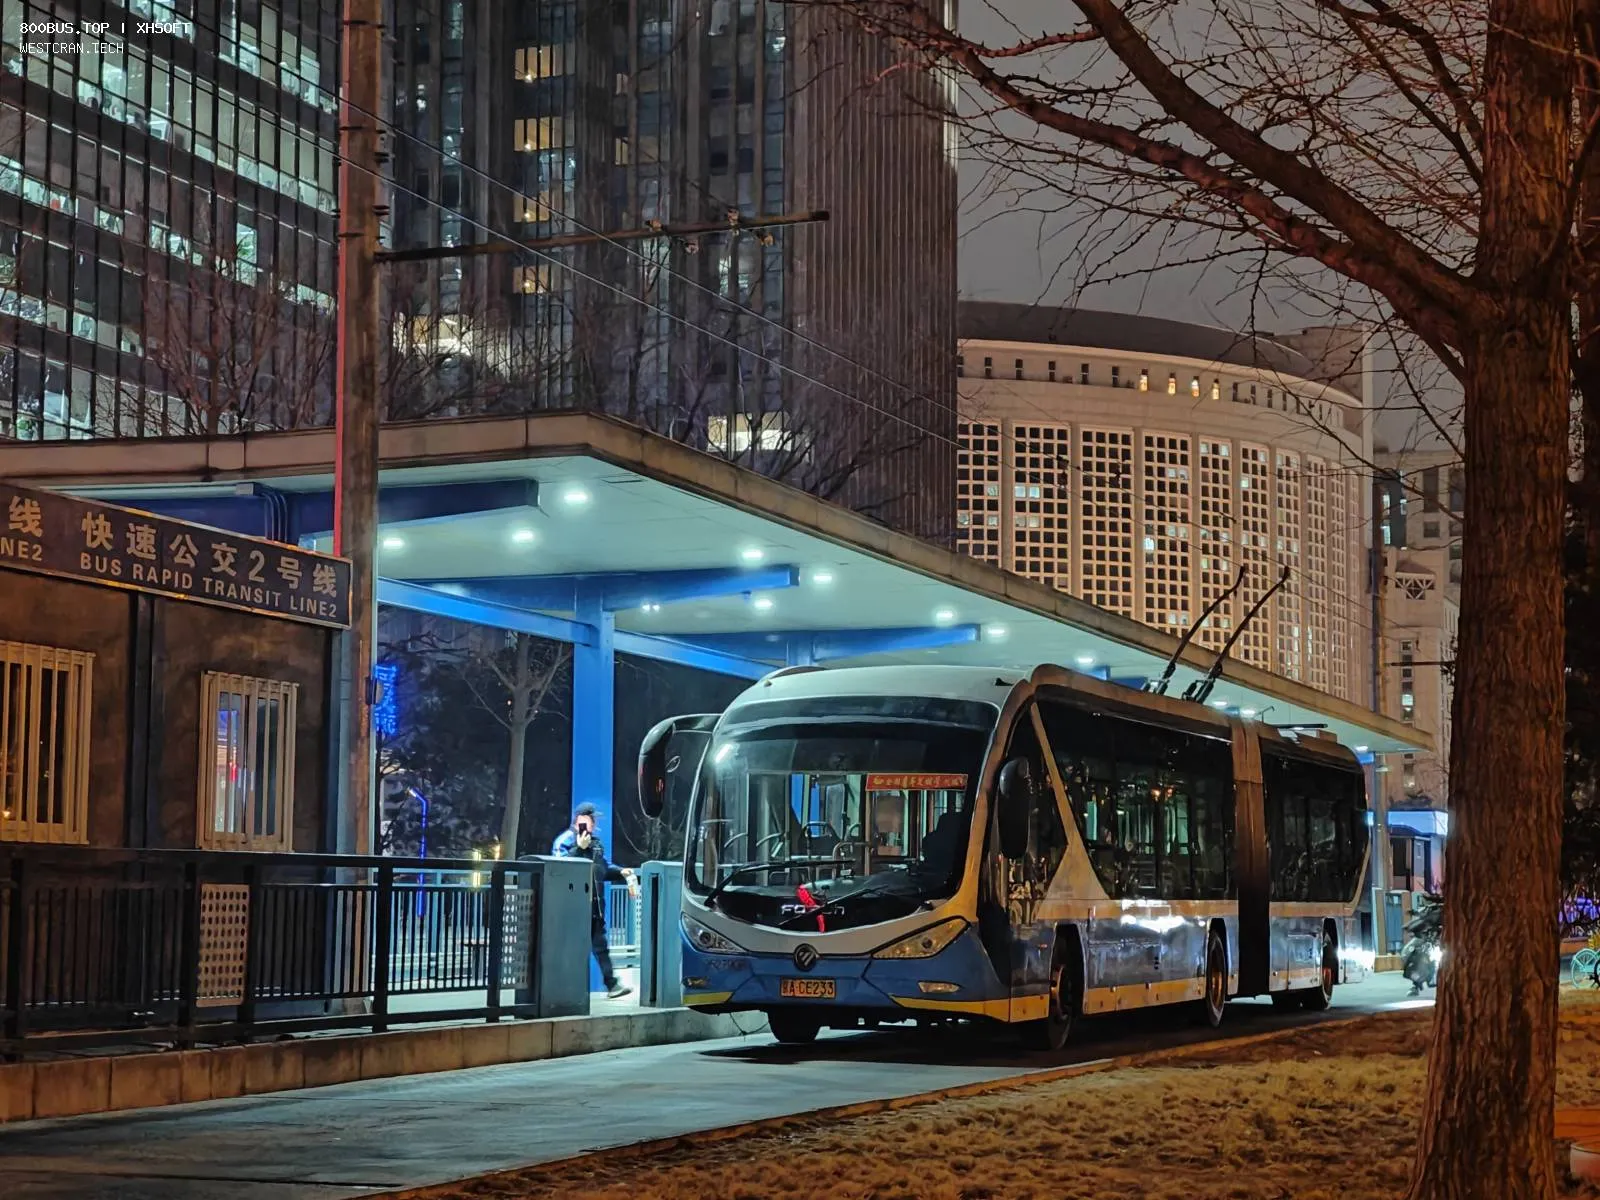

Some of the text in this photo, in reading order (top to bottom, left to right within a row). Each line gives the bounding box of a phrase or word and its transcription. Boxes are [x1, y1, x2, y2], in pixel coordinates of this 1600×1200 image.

[8, 495, 43, 537] 线
[80, 551, 337, 618] BUS RAPID TRANSIT LINE2
[81, 511, 337, 598] 快速公交2号线
